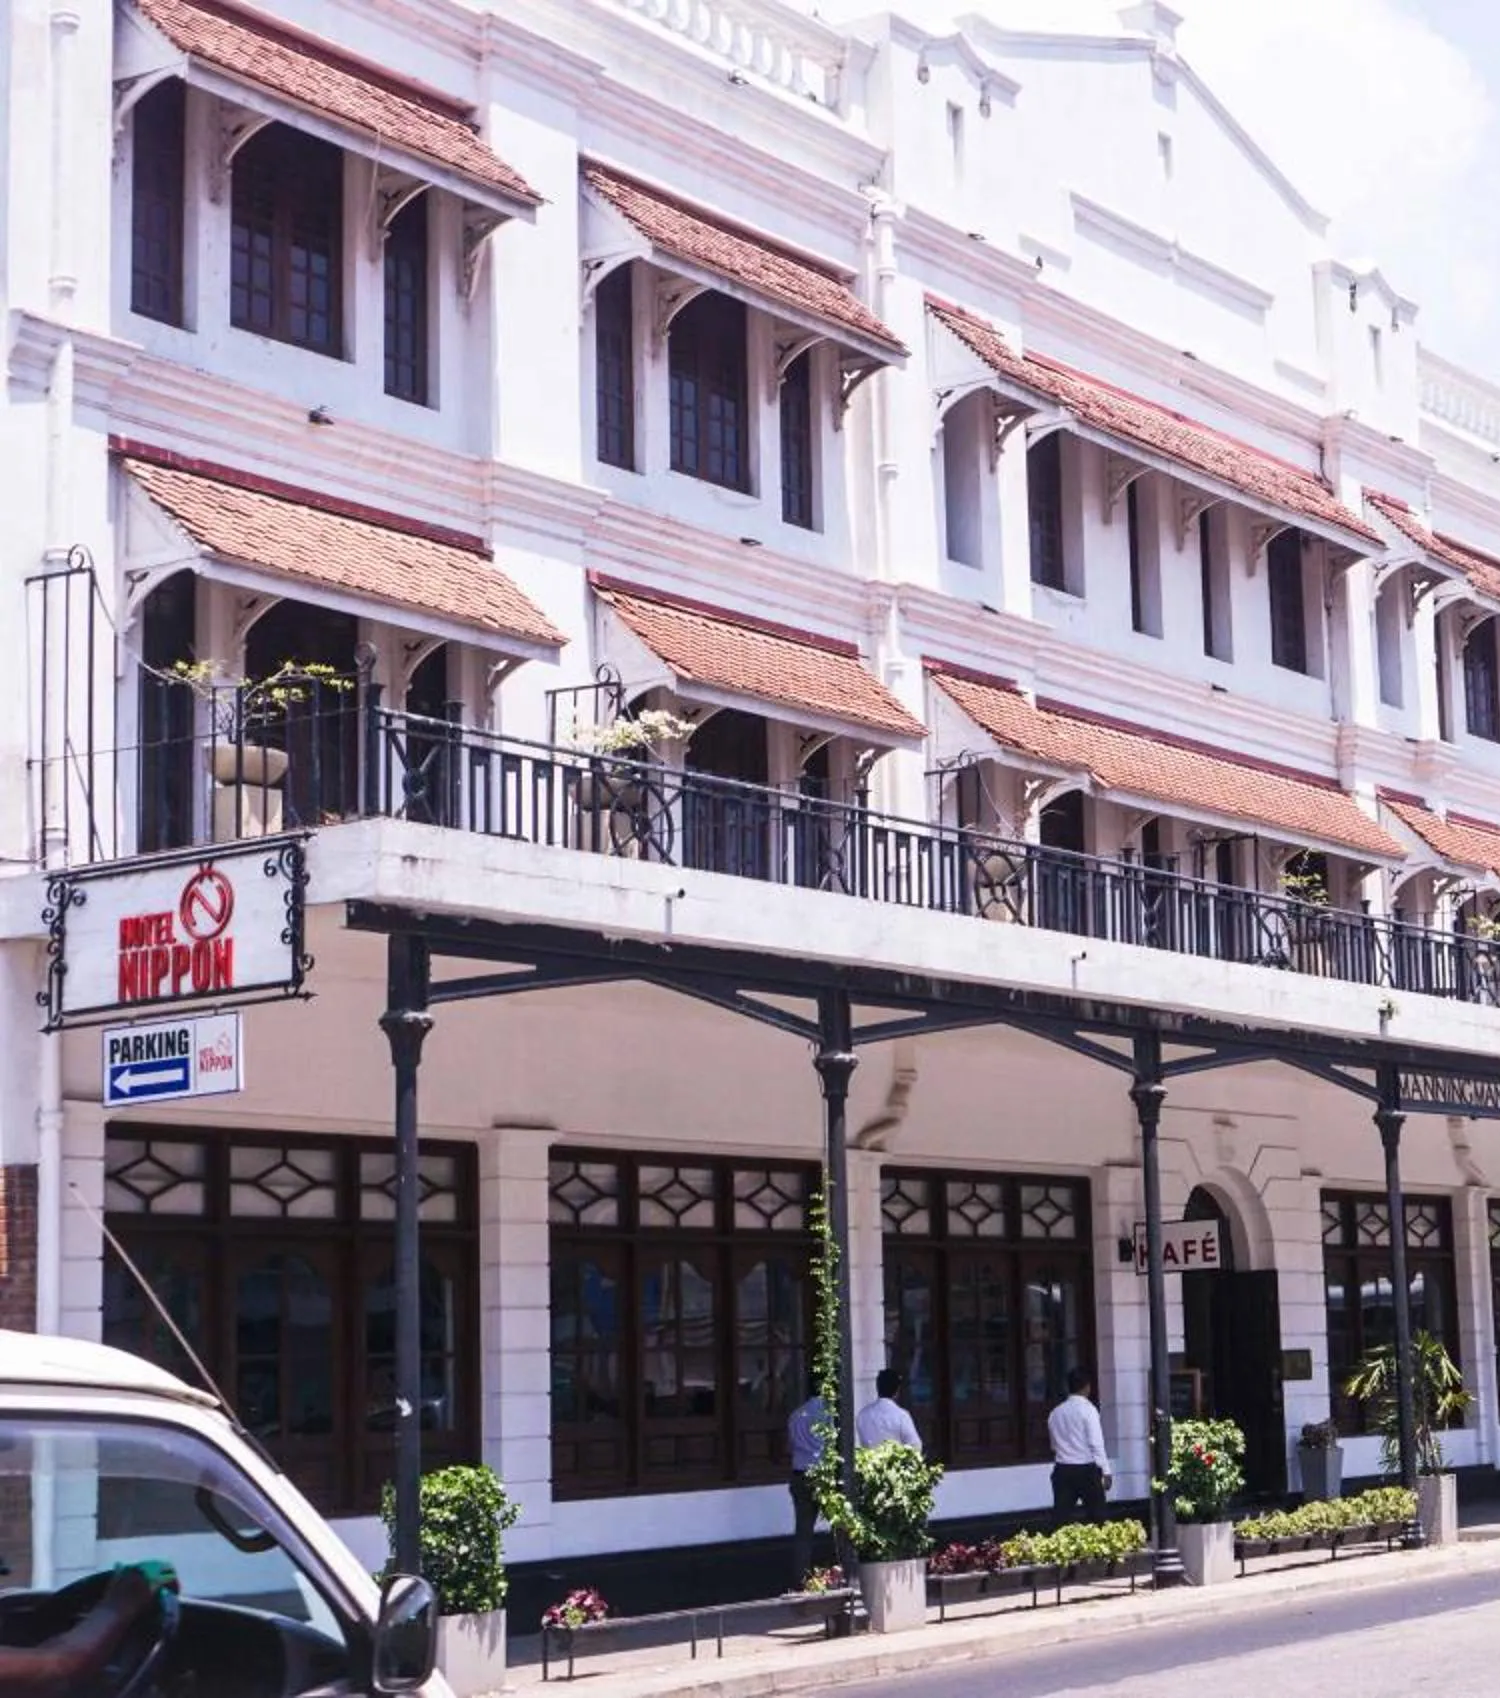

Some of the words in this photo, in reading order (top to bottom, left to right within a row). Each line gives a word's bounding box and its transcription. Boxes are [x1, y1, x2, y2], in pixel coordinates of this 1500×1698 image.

[119, 910, 177, 950] HOTEL
[118, 937, 234, 1003] NIPPON
[109, 1029, 190, 1064] PARKING
